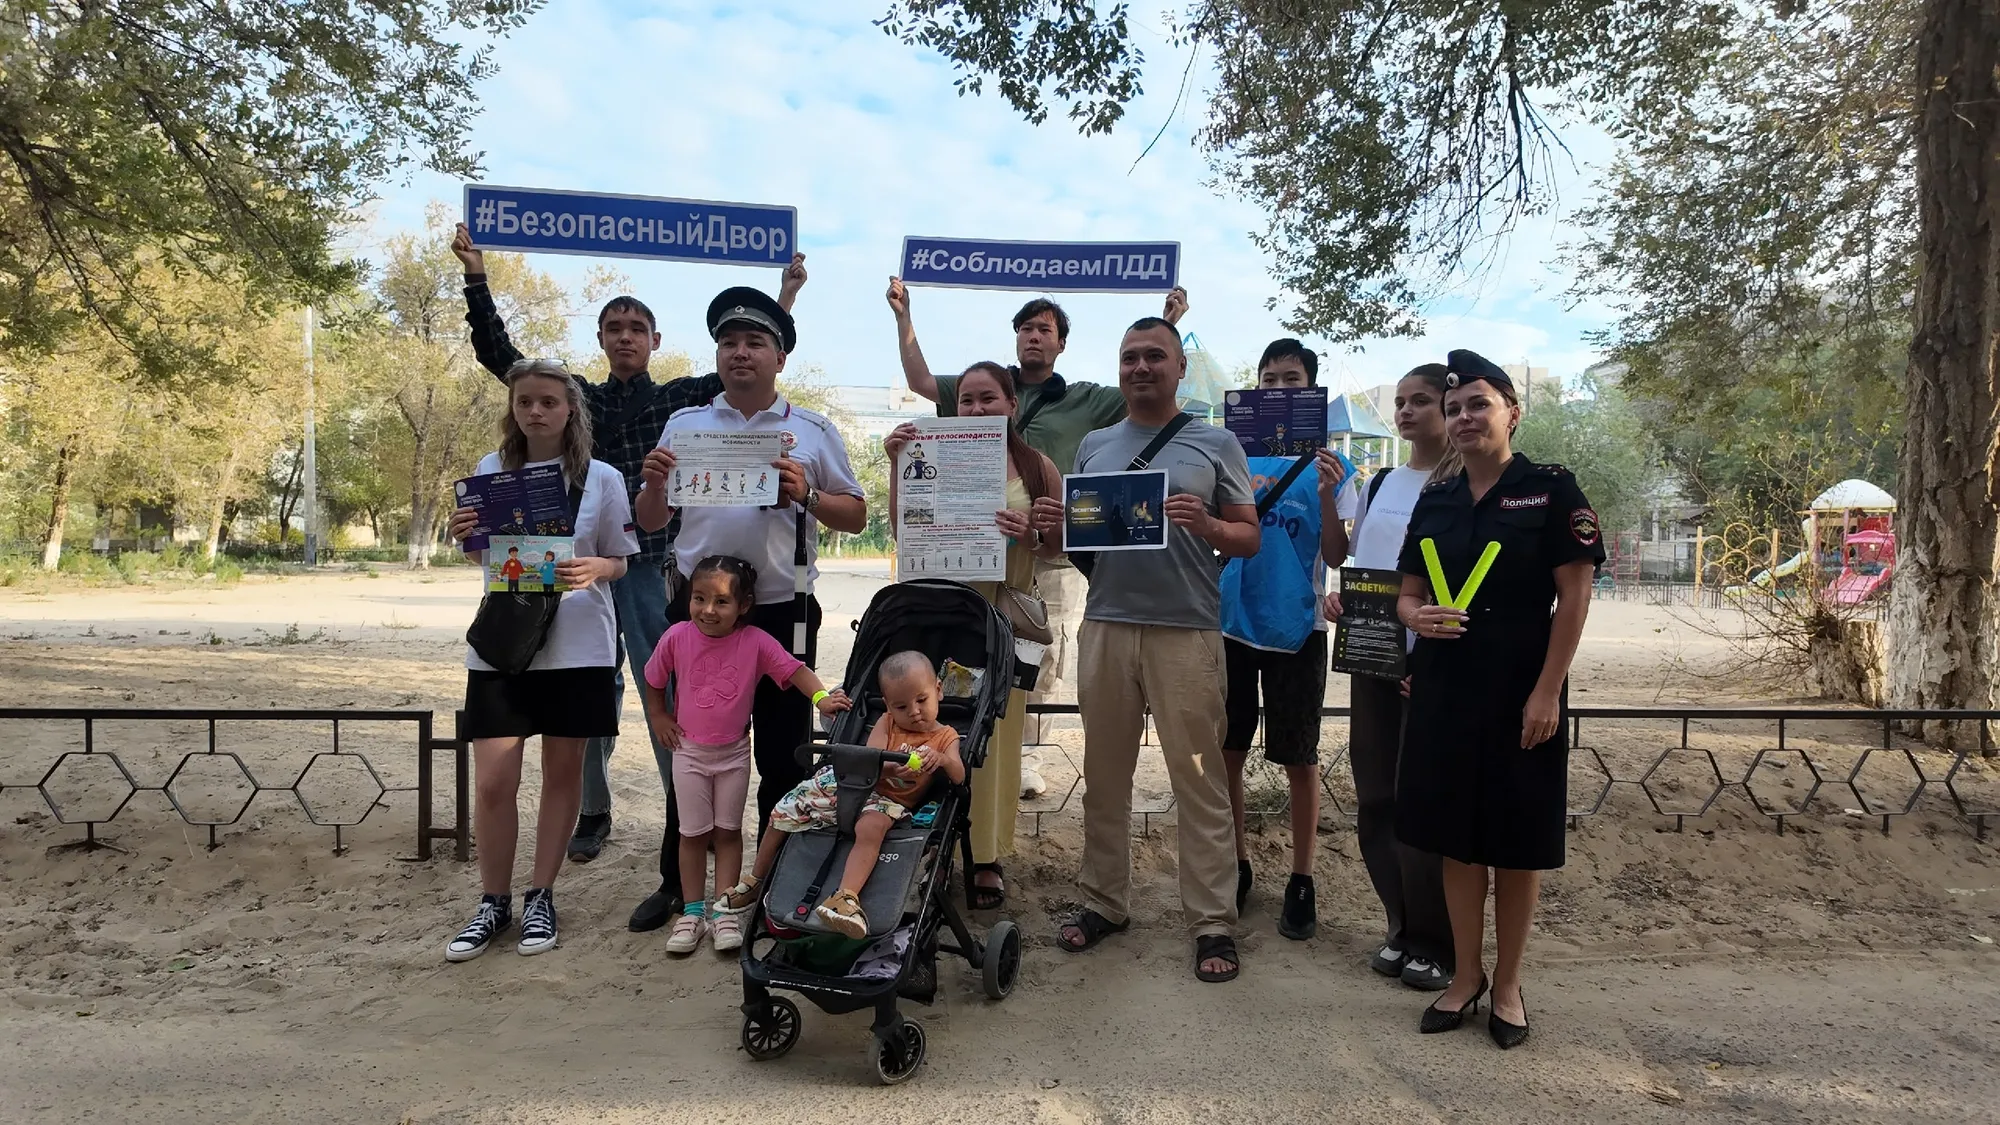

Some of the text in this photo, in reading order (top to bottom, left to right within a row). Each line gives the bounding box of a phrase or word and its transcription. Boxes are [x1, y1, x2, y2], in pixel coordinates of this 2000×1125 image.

[475, 198, 787, 259] #БезопасныйДвор
[911, 248, 1167, 280] #СоблюдаемПДД
[1503, 496, 1547, 507] ПОЛИЦИЯ
